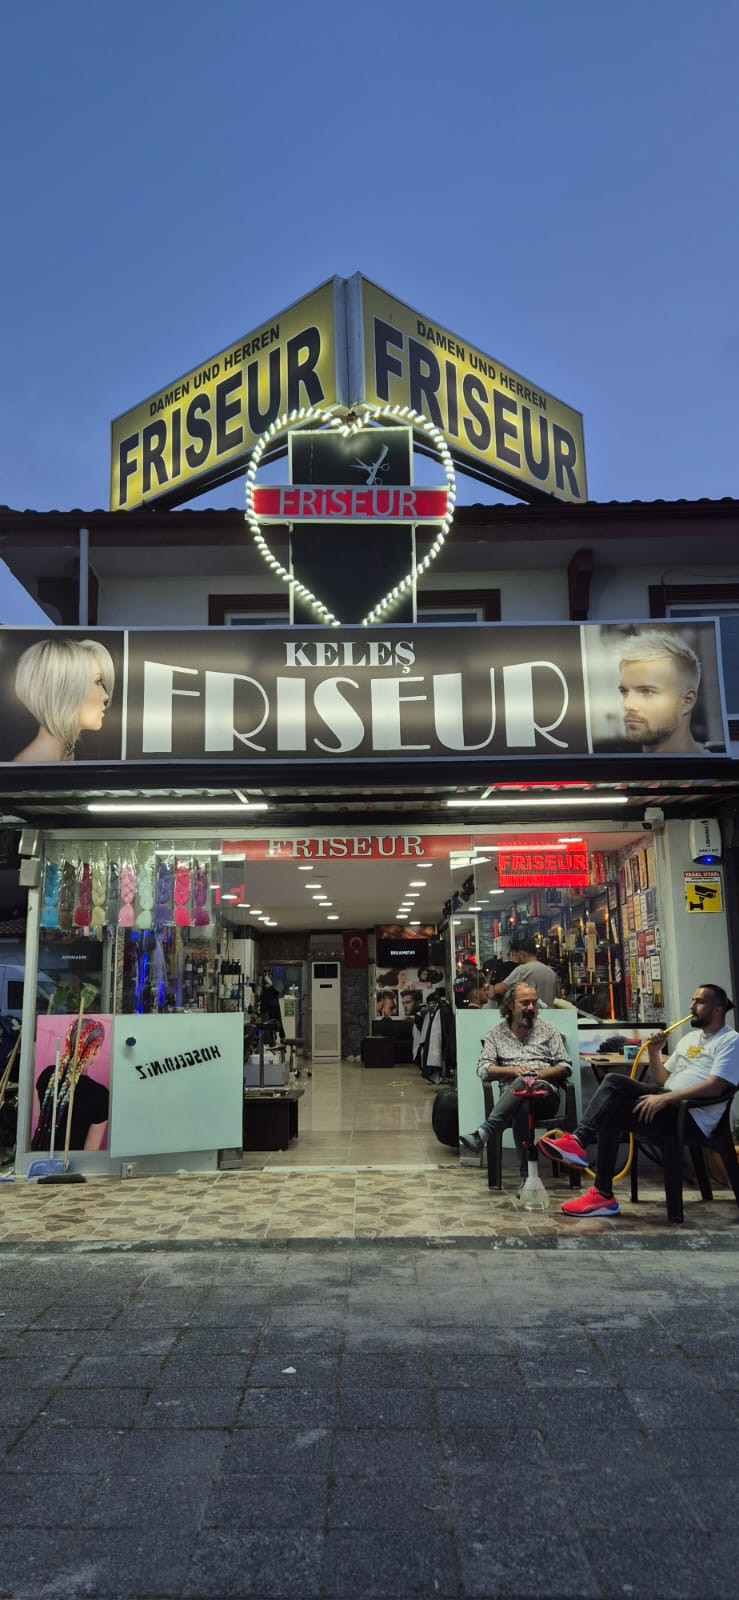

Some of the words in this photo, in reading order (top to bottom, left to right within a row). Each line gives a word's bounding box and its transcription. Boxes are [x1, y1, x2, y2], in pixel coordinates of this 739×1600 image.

[150, 381, 190, 417] DAMEN
[193, 363, 220, 389] UND
[224, 324, 280, 372] HERREN
[374, 316, 581, 499] FRISEUR
[417, 319, 465, 362] DAMEN
[469, 353, 496, 380] UND
[500, 372, 547, 411] HERREN
[118, 326, 325, 508] FRISEUR
[283, 640, 417, 674] KELEŞ
[142, 660, 569, 753] FRISEUR
[266, 835, 425, 858] FRISEUR
[499, 854, 588, 871] FRISEUR
